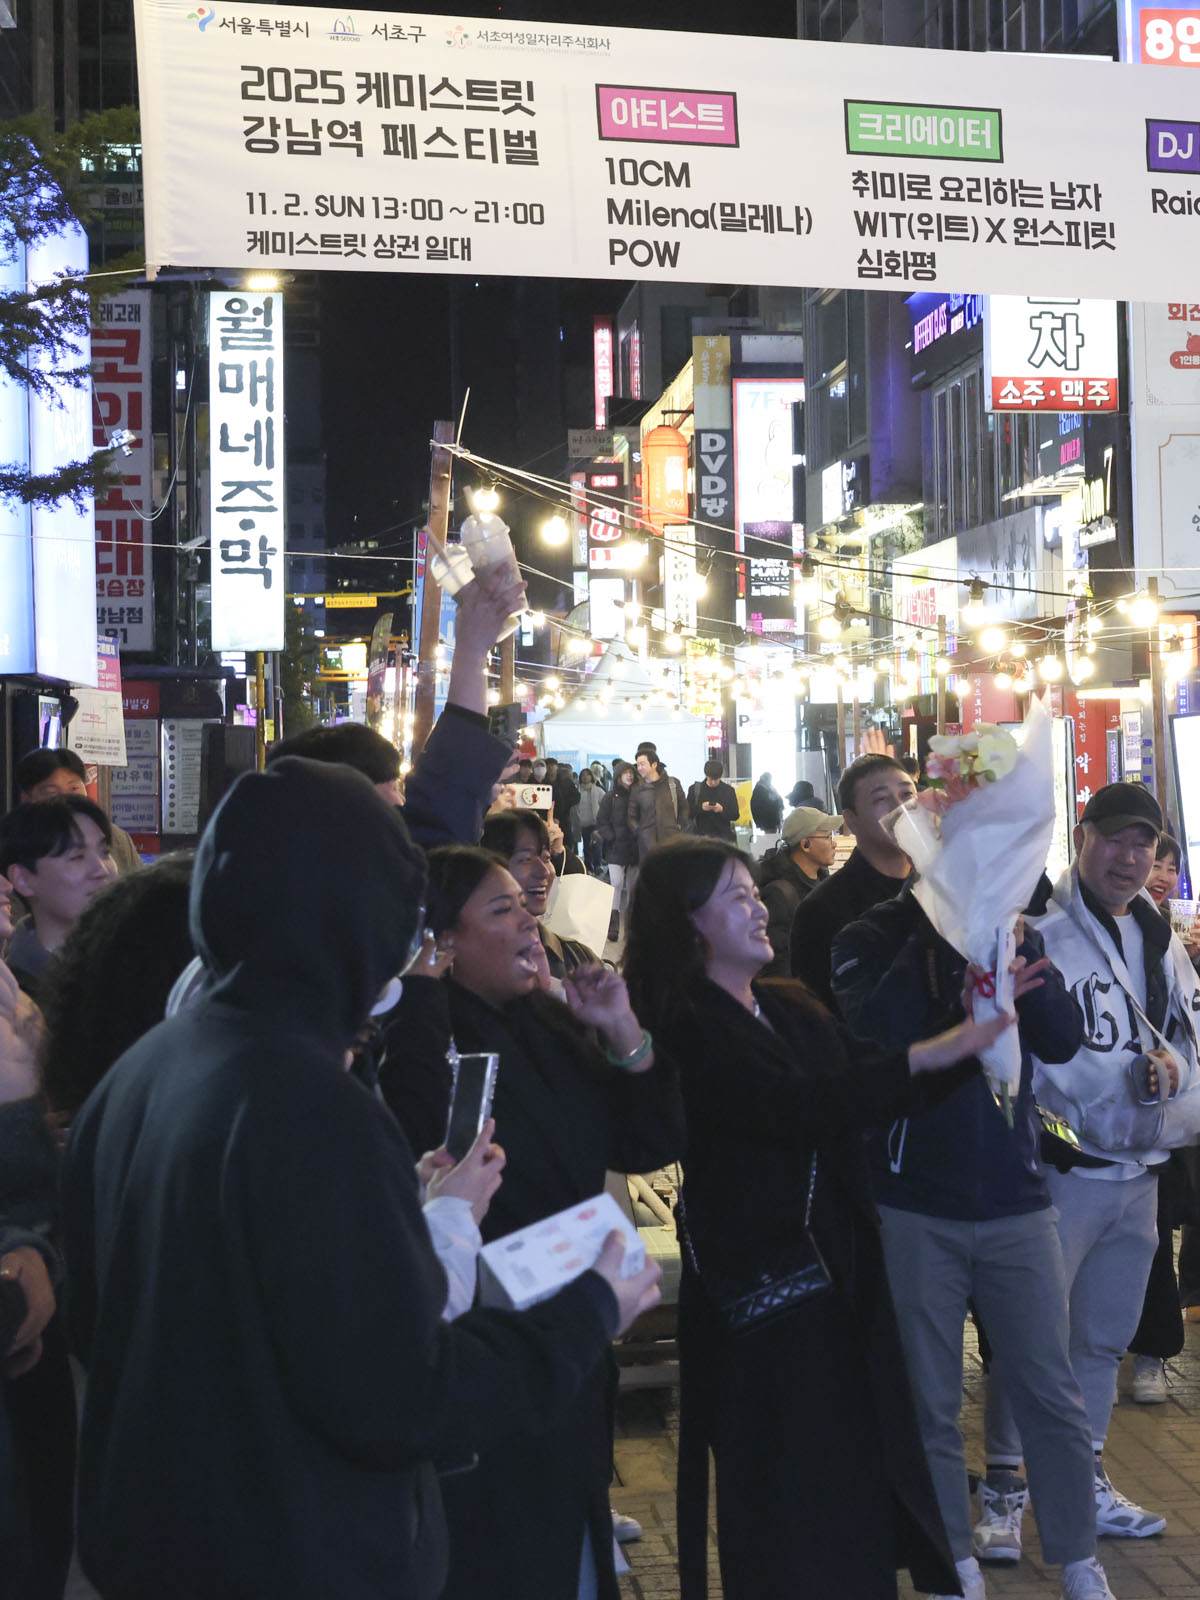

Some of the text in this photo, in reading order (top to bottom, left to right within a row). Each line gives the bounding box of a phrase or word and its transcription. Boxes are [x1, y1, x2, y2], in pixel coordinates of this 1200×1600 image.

[219, 16, 310, 38] 서울특별시
[371, 23, 427, 43] 서초구
[476, 30, 611, 50] 서초여성일자리주식회사
[241, 65, 536, 118] 2025 케미스트릿
[611, 97, 725, 131] 아티스트
[858, 112, 993, 149] 크리에이터
[242, 116, 540, 166] 강남역 페스티벌
[1157, 131, 1194, 160] DJ
[606, 157, 691, 189] 10CM
[315, 195, 365, 219] SUN
[852, 170, 1102, 212] 취미로 요리하는 남자
[607, 198, 813, 236] Milena(밀레나)
[854, 211, 1117, 251] WIT(위트) X 원스피릿
[246, 230, 472, 262] 케미스트릿 상권 일대
[609, 240, 681, 269] POW
[857, 250, 938, 282] 심화평
[1026, 296, 1085, 371] 차
[216, 296, 278, 590] 월매네주막
[700, 432, 730, 518] DVD방
